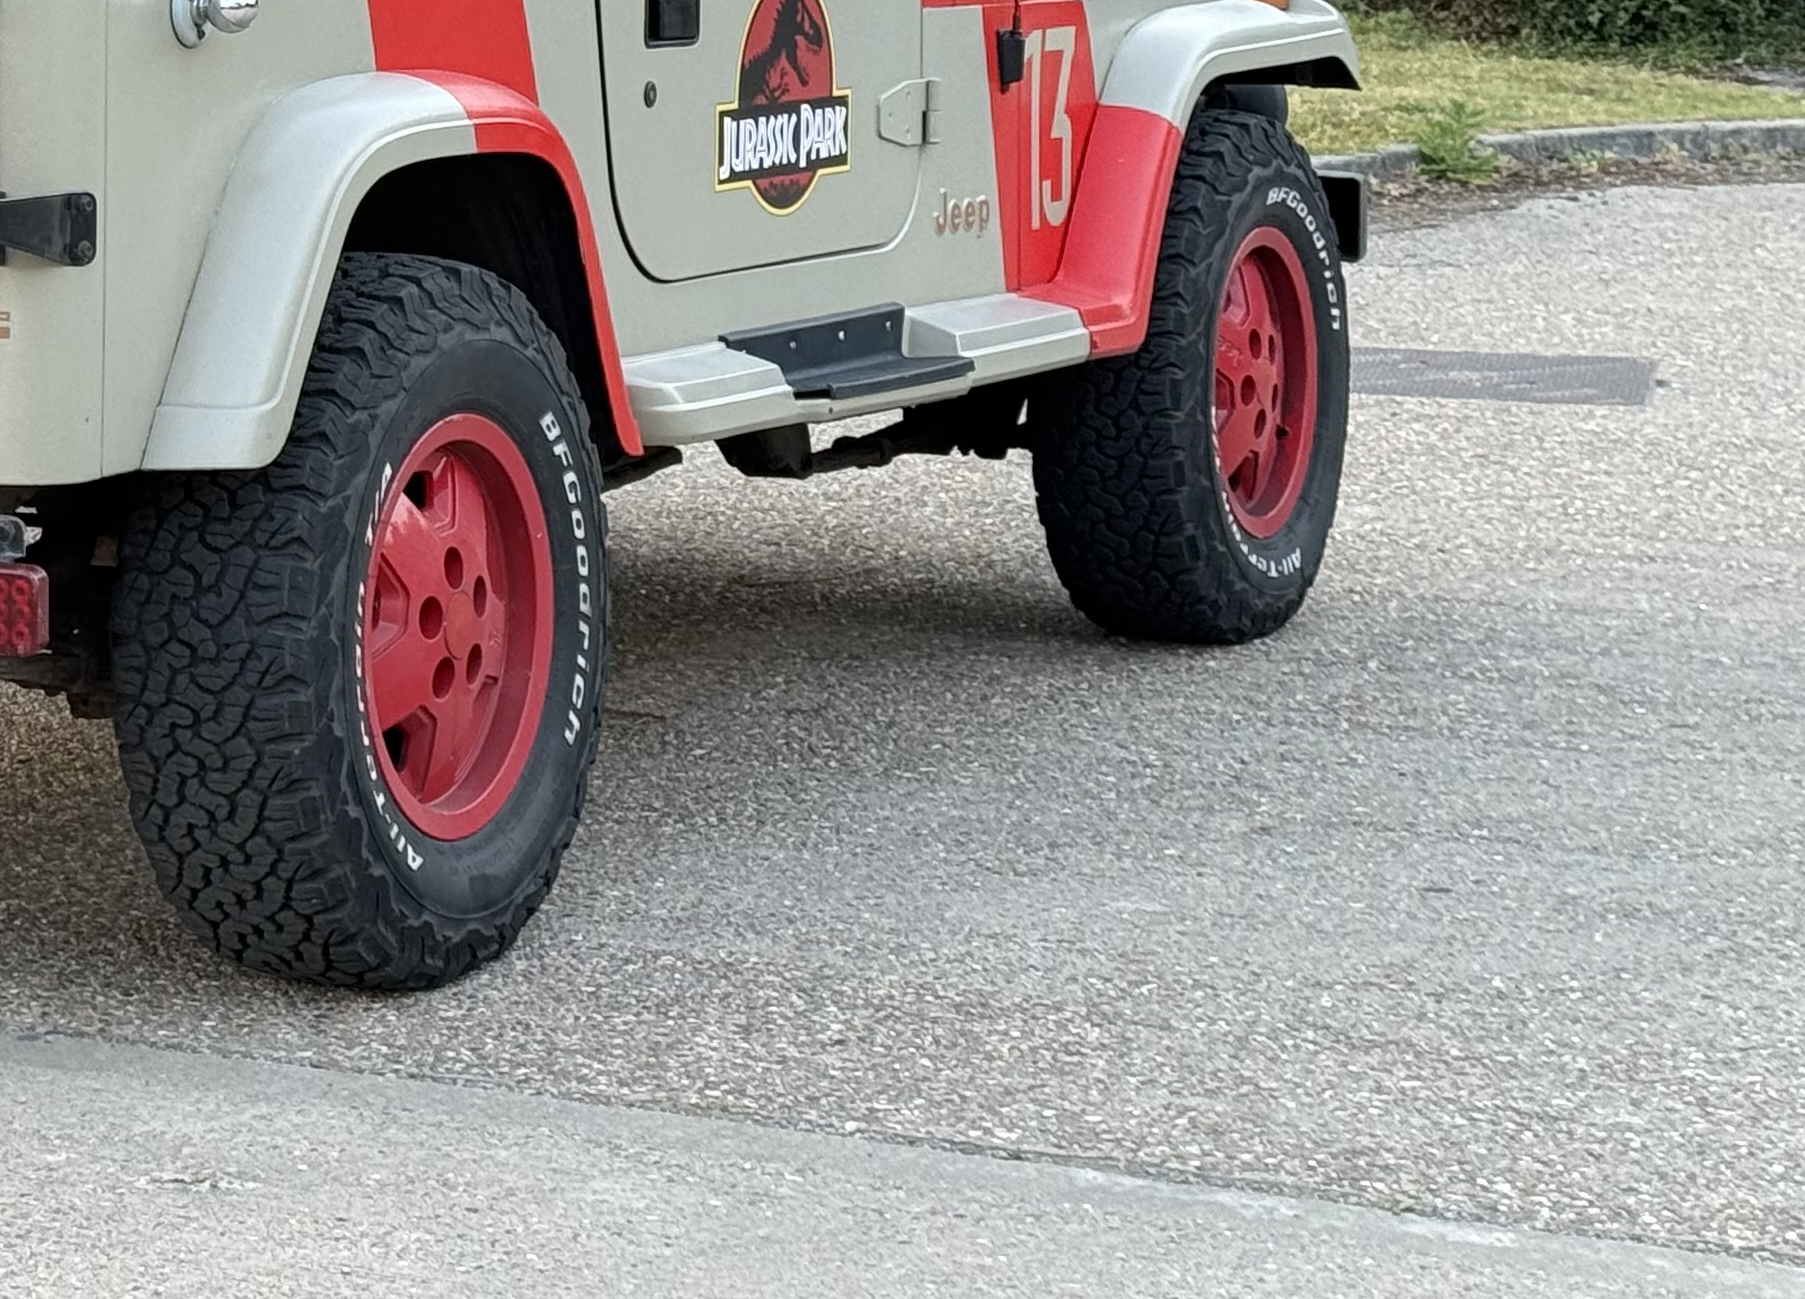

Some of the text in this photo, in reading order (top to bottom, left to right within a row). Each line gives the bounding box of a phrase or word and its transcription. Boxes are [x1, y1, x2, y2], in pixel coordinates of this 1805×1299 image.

[719, 103, 847, 181] JURASSIC PARK
[1023, 25, 1077, 231] 13
[932, 187, 991, 238] Jeep
[539, 410, 593, 748] BFGoodrich
